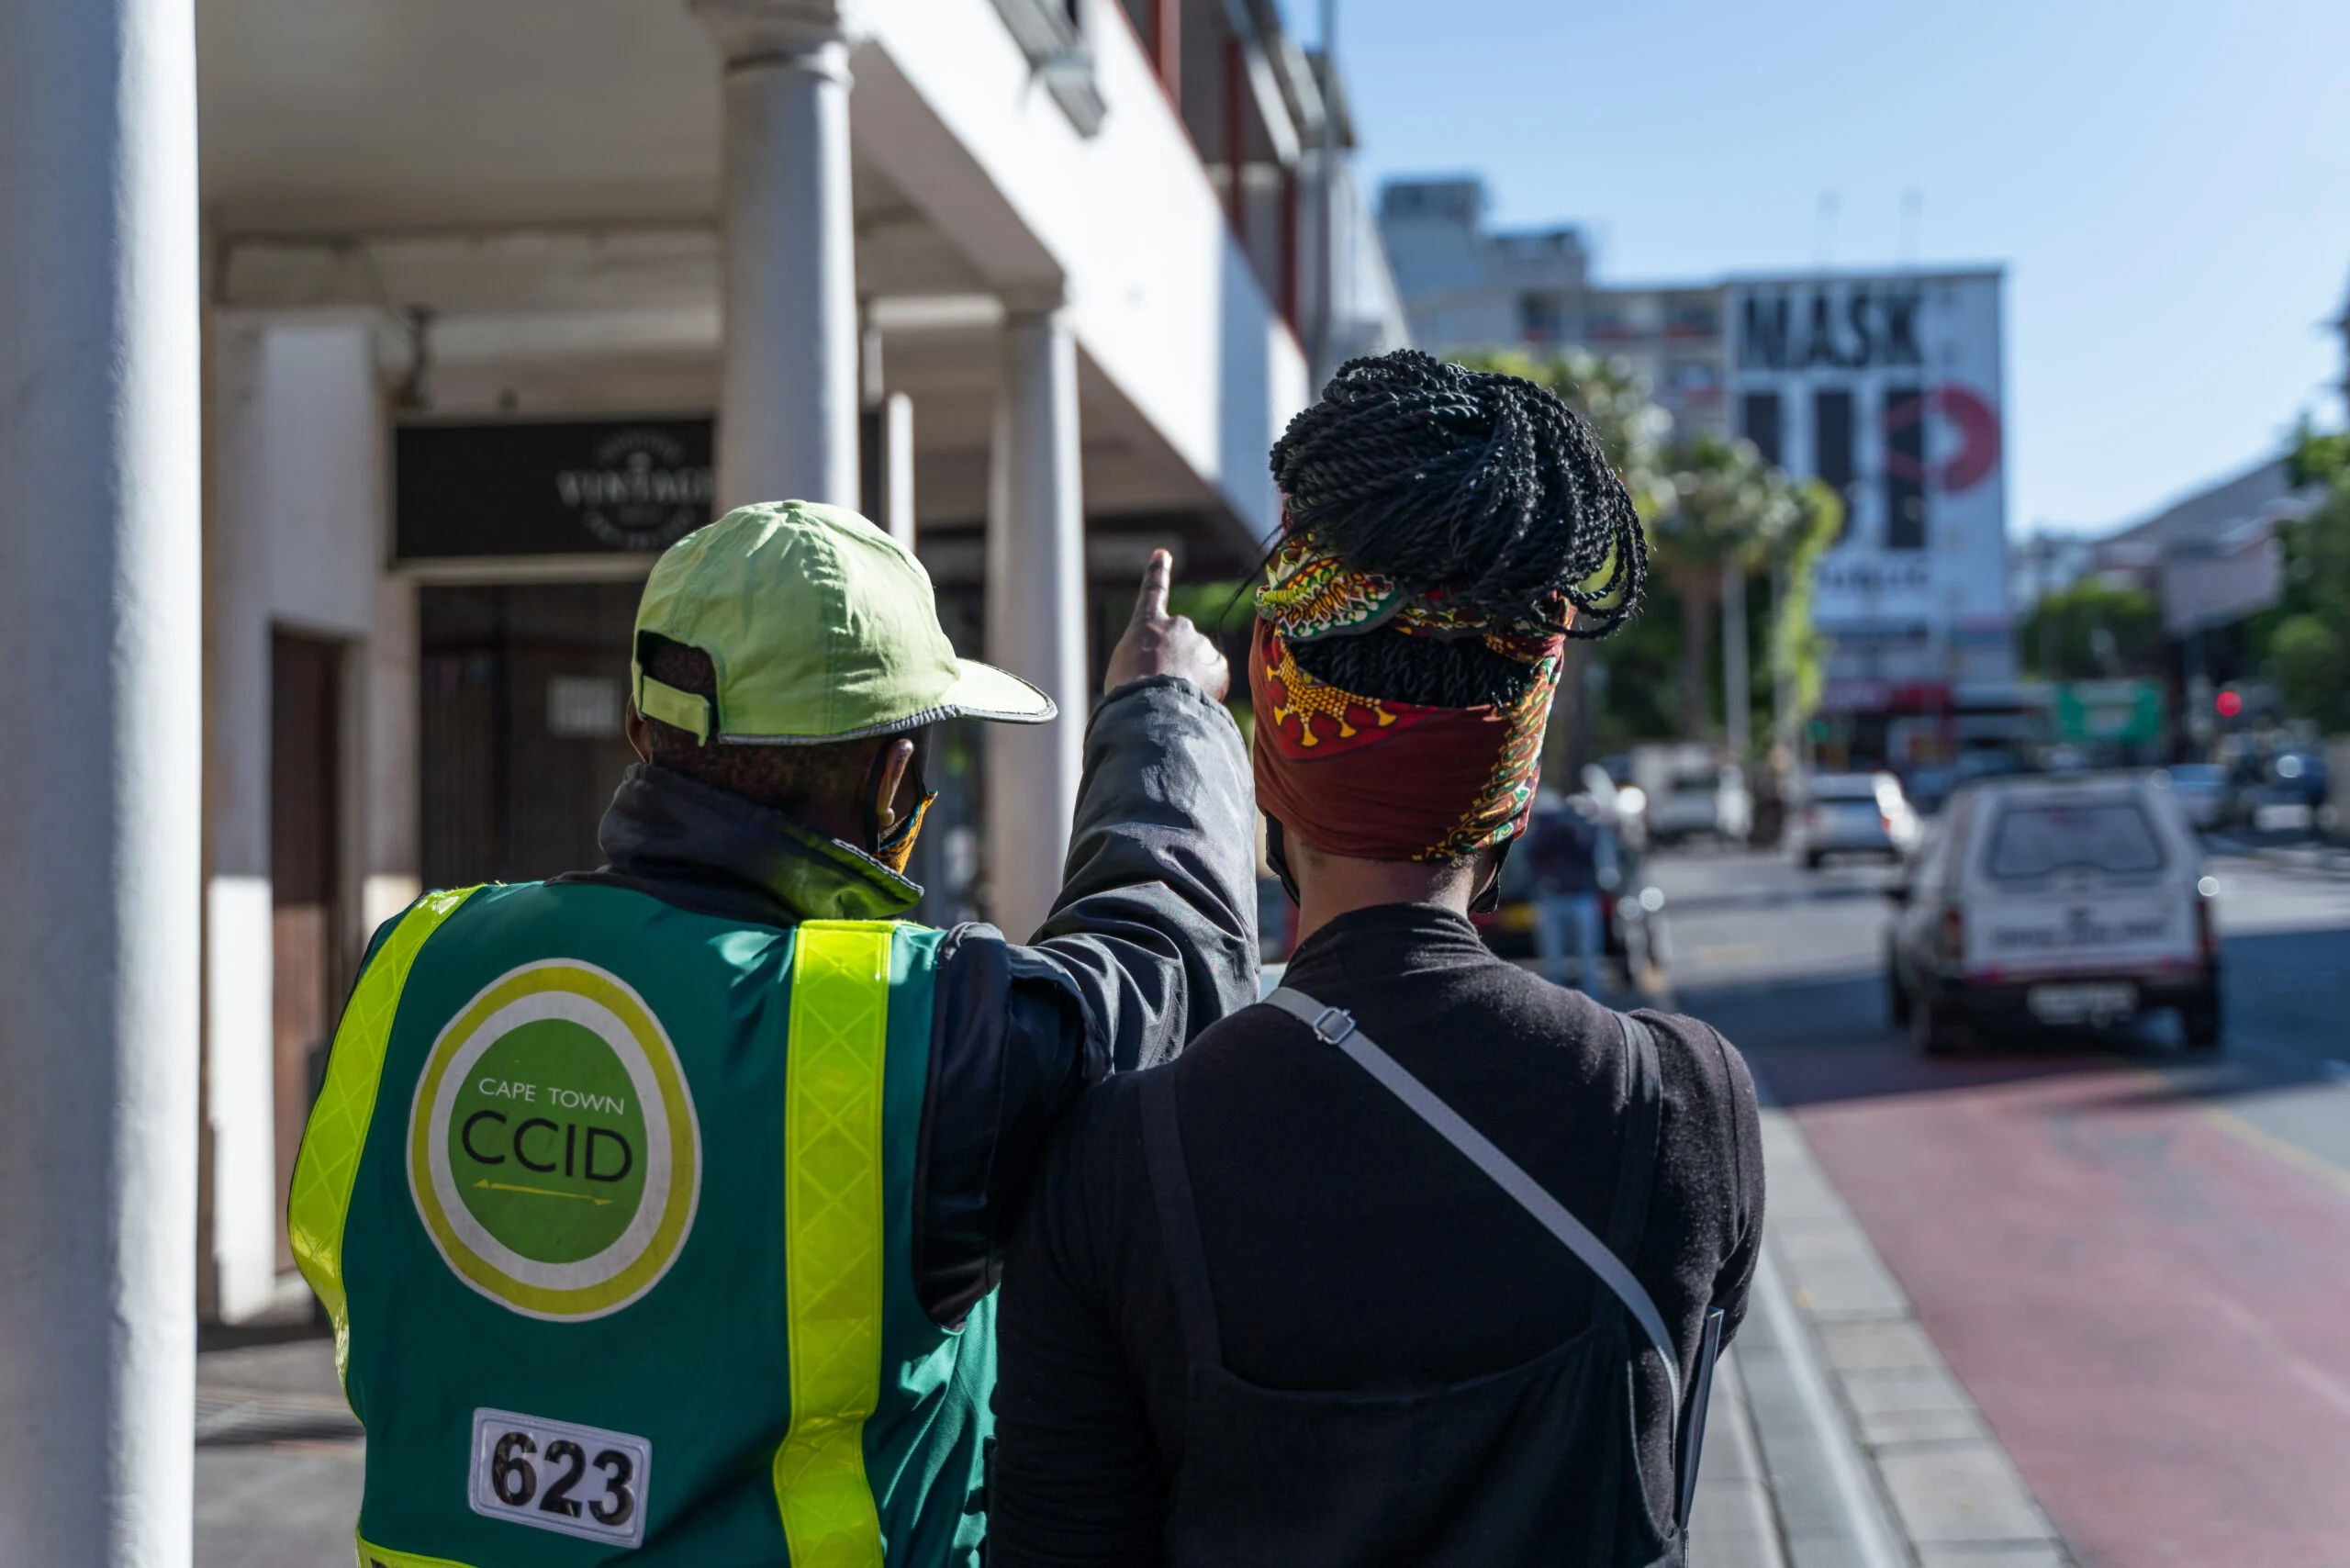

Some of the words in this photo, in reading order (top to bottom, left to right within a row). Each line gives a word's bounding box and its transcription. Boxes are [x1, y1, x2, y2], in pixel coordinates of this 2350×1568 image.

[1740, 288, 1925, 370] MASK
[478, 1077, 537, 1103] CAPE
[547, 1086, 625, 1115] TOWN
[461, 1109, 633, 1183] CCID
[490, 1430, 635, 1527] 623
